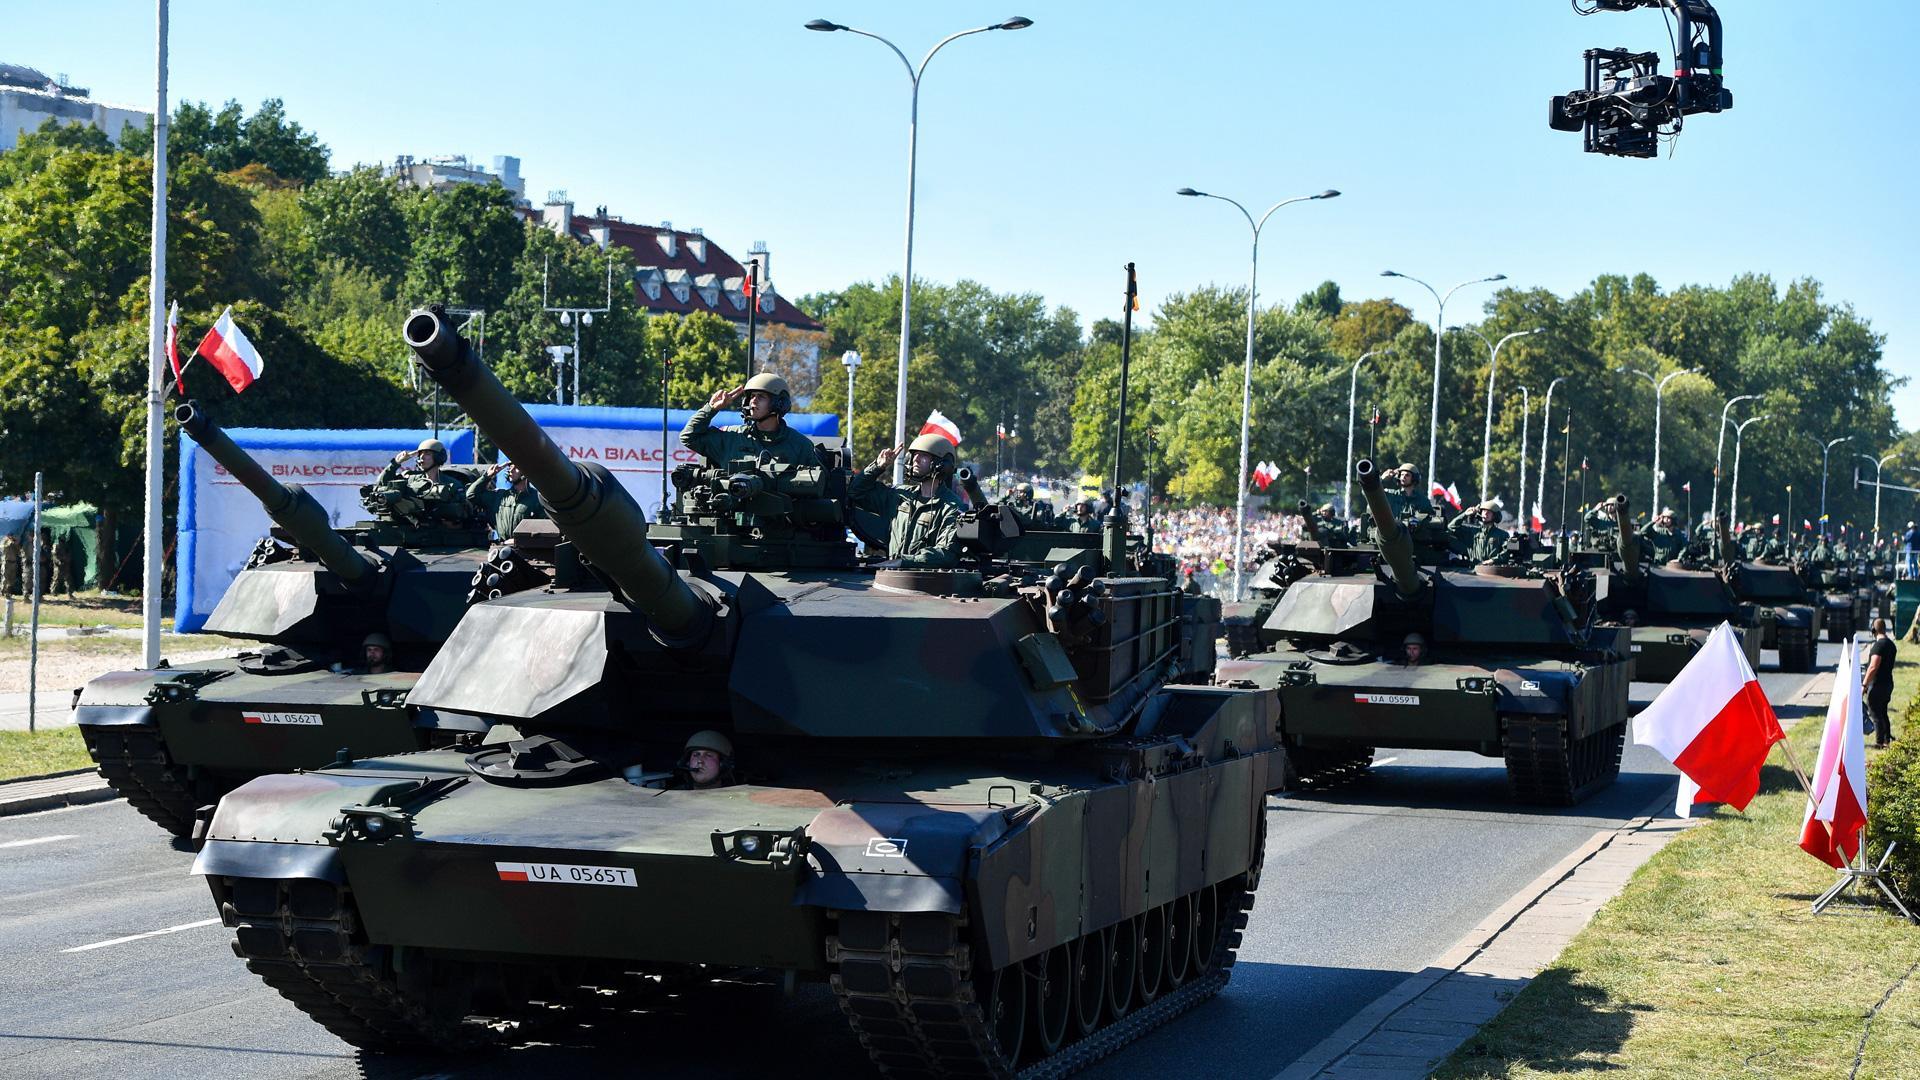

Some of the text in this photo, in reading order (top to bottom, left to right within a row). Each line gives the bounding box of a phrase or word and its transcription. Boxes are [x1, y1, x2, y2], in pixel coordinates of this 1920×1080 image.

[604, 447, 699, 463] BIAŁO-CZ
[1370, 695, 1416, 704] UA 0559T
[262, 713, 318, 724] UA 0562T
[531, 865, 628, 884] UA 0565T
